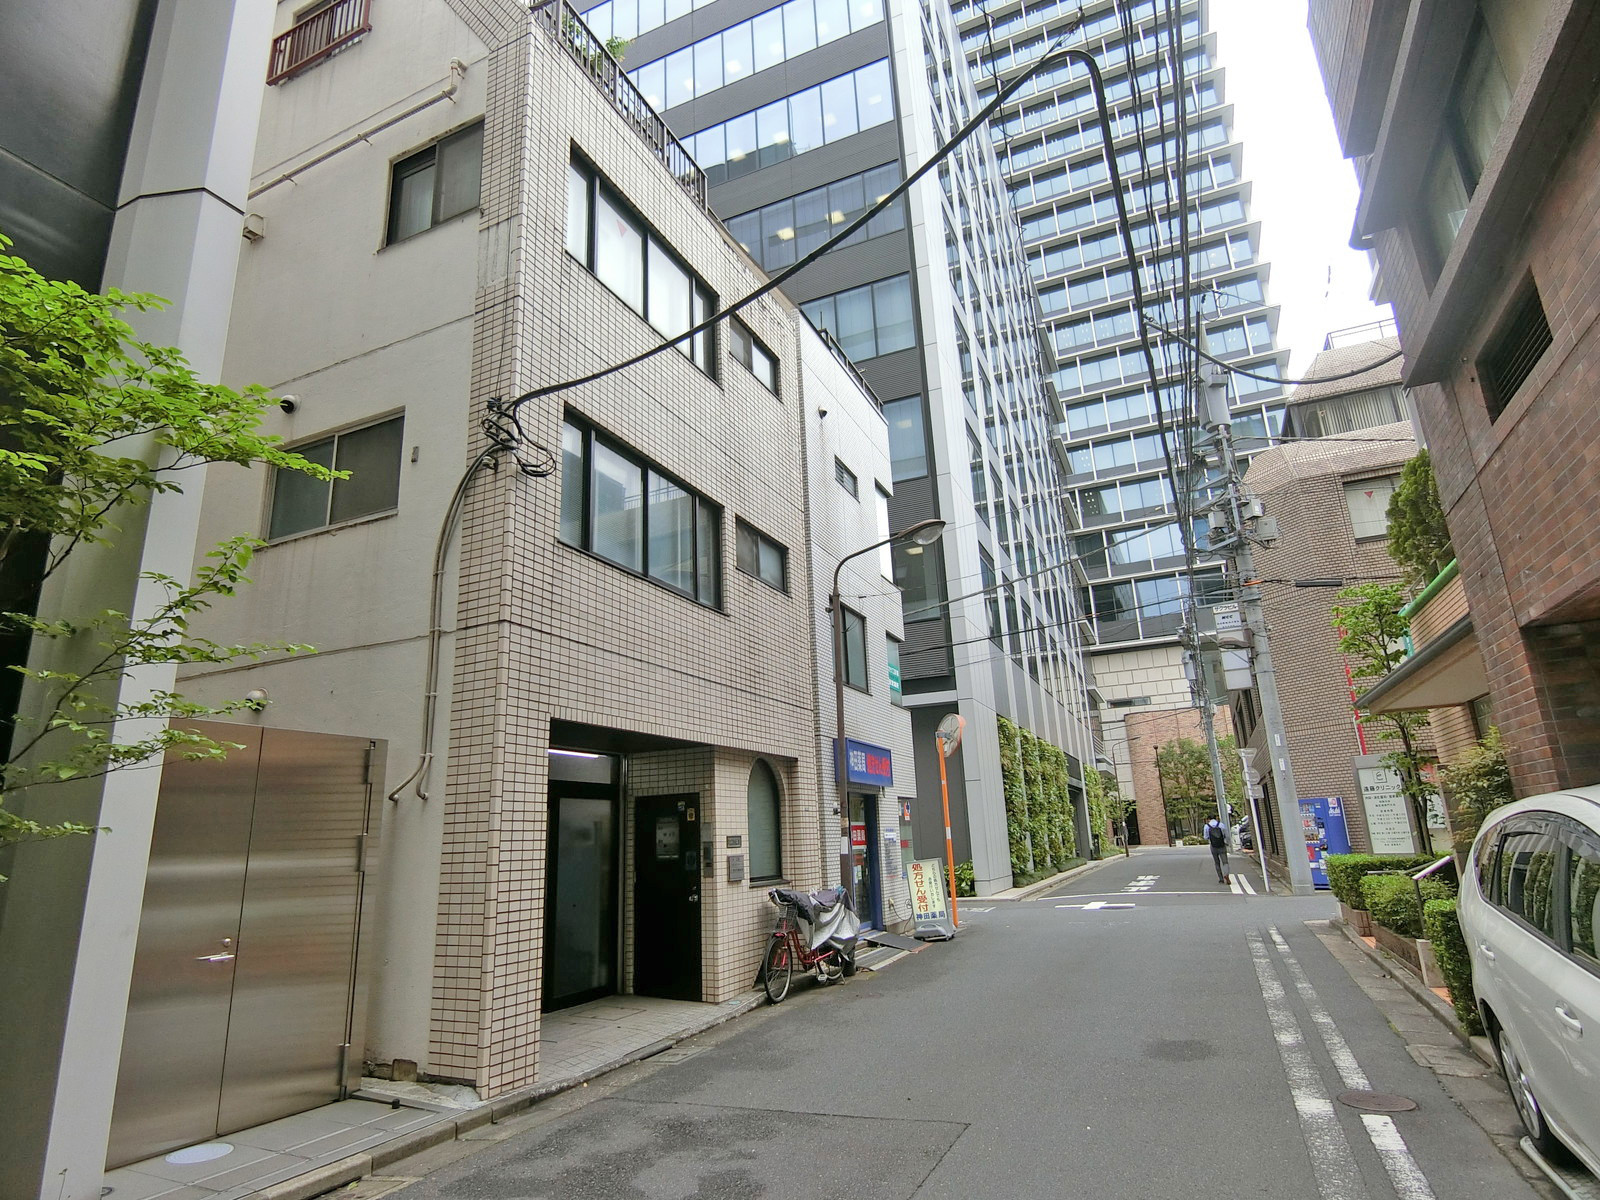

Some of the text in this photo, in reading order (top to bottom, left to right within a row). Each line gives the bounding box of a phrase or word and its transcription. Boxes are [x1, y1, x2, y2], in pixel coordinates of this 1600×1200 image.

[912, 863, 929, 912] 処方せん受付
[916, 910, 945, 920] 神田薬局
